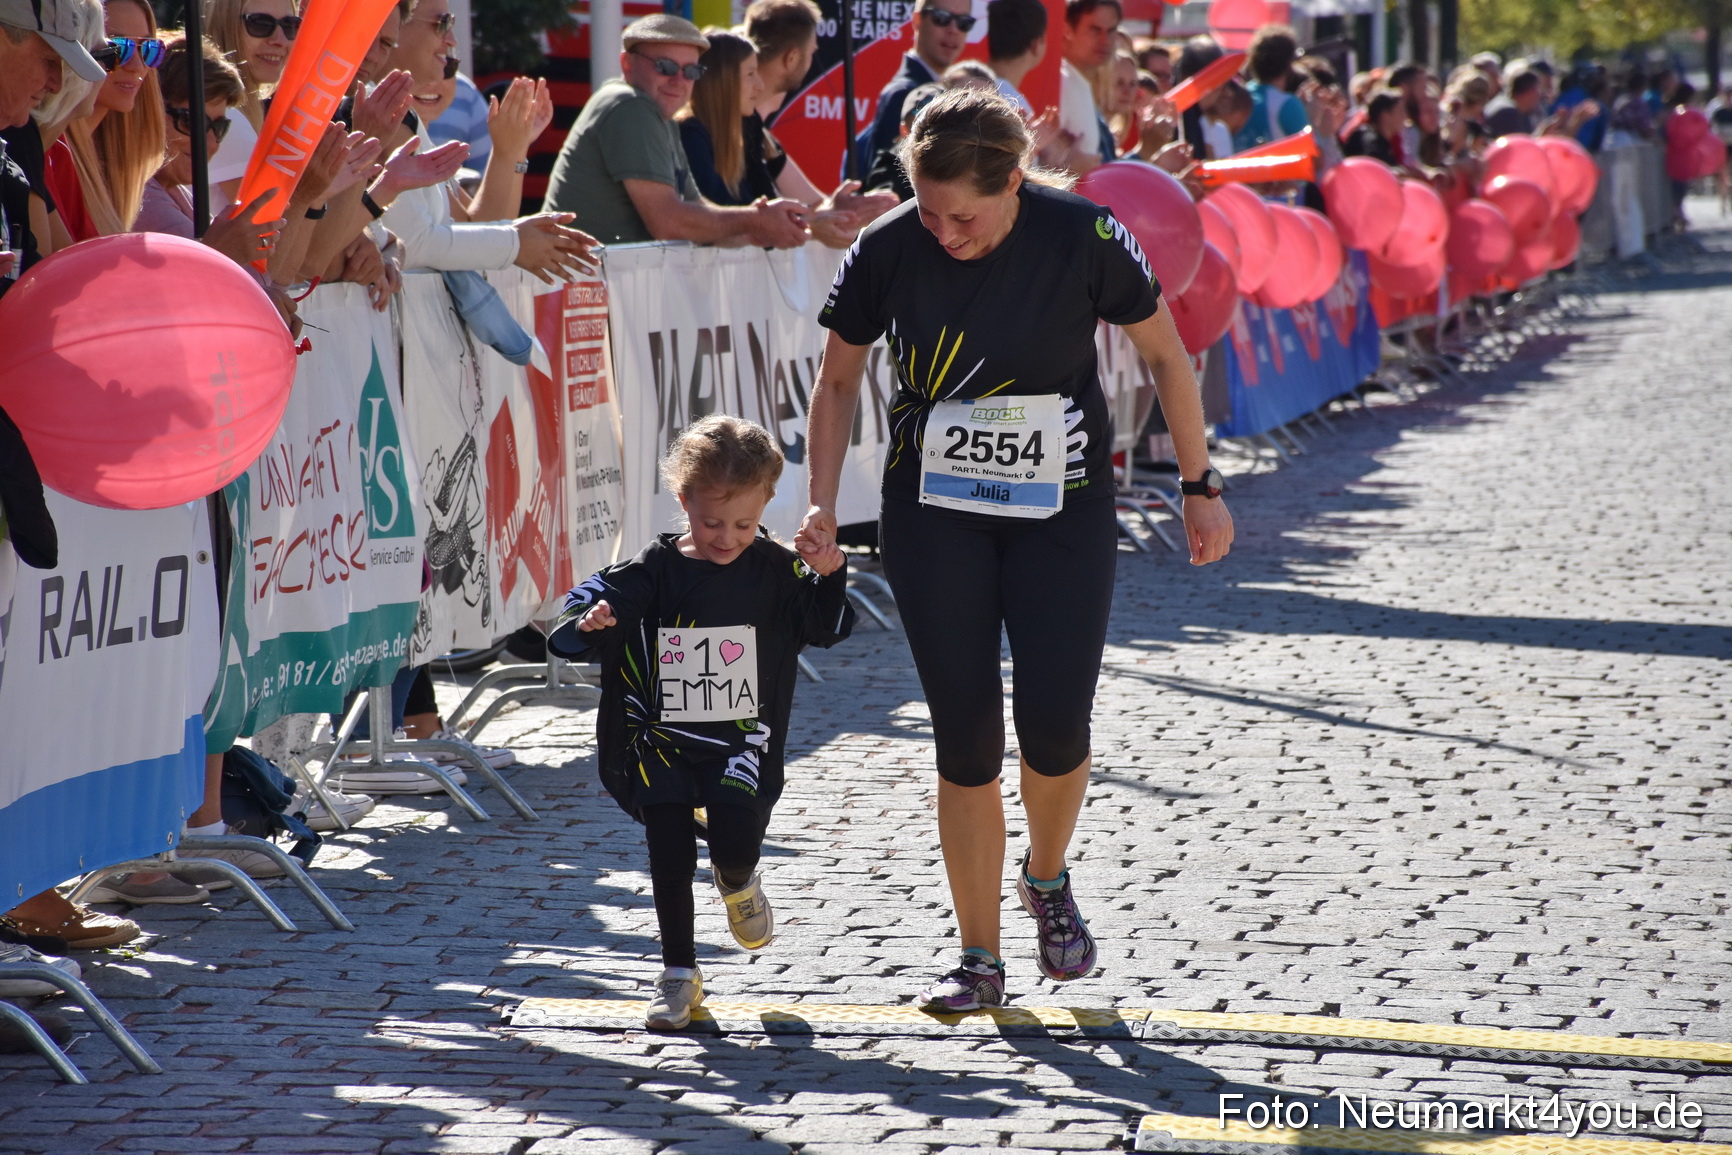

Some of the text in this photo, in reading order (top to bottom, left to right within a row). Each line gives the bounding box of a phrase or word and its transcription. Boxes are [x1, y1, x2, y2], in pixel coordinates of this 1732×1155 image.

[877, 1, 915, 20] NEX
[265, 49, 354, 178] DEHN
[971, 406, 1026, 421] BOCK
[943, 426, 1045, 467] 2554
[951, 465, 1023, 479] PARTL Neumarkt
[970, 480, 1011, 502] Julia
[39, 555, 189, 664] RAIL.O
[694, 637, 719, 677] 1
[659, 678, 755, 711] EMMA
